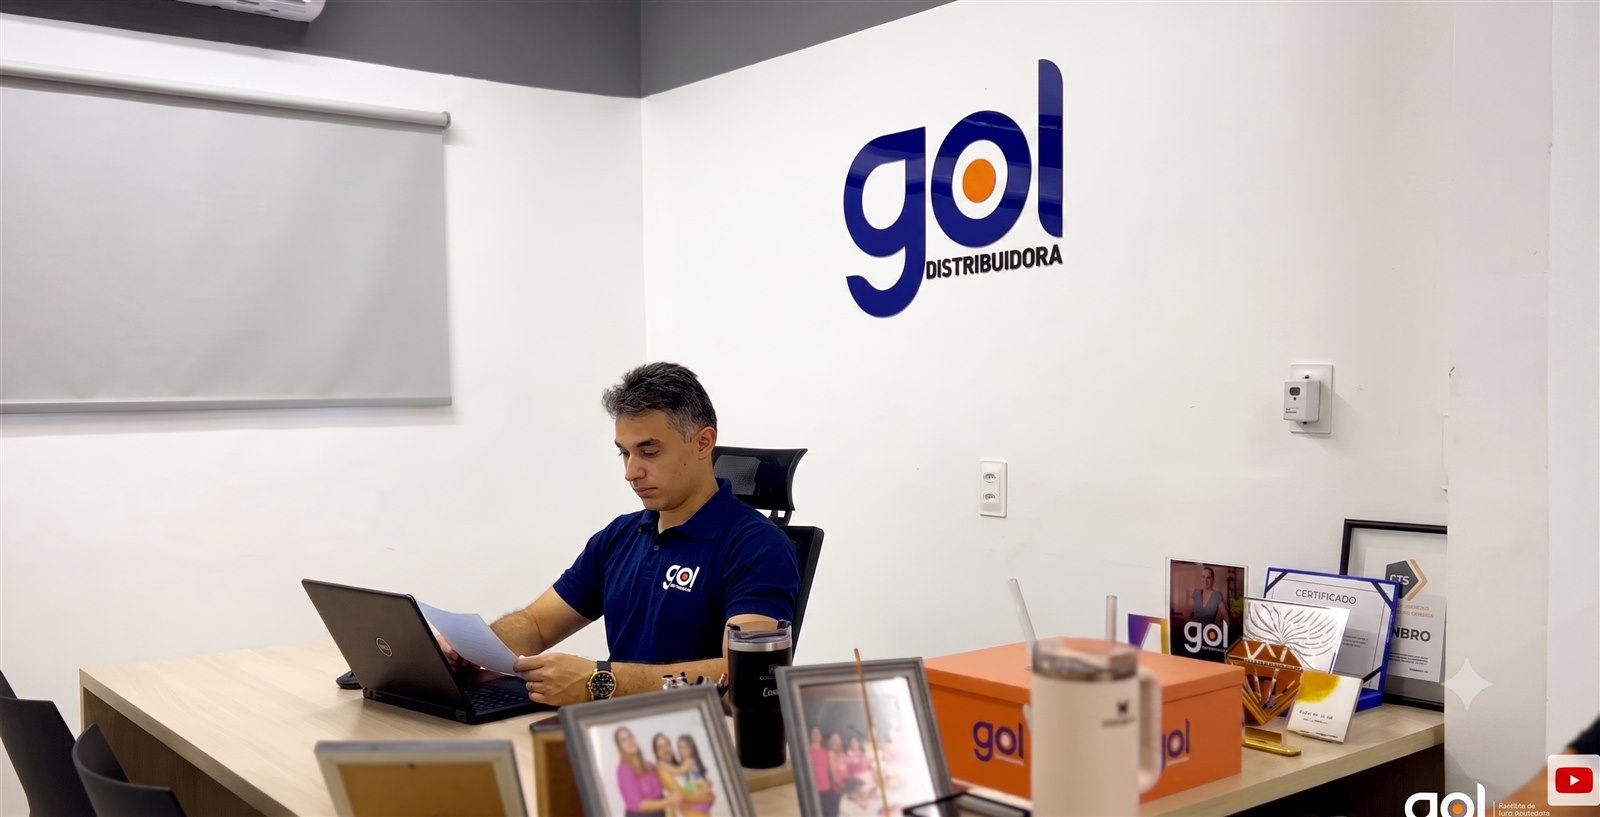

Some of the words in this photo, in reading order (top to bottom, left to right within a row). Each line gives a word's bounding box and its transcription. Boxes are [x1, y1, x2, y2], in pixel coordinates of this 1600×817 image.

[844, 59, 1063, 318] gol
[926, 244, 1063, 280] DISTRIBUIDORA
[663, 564, 700, 590] gol
[1295, 589, 1357, 605] CERTIFICADO
[1184, 620, 1228, 653] gol
[972, 721, 1024, 762] gol
[1161, 719, 1190, 773] ol
